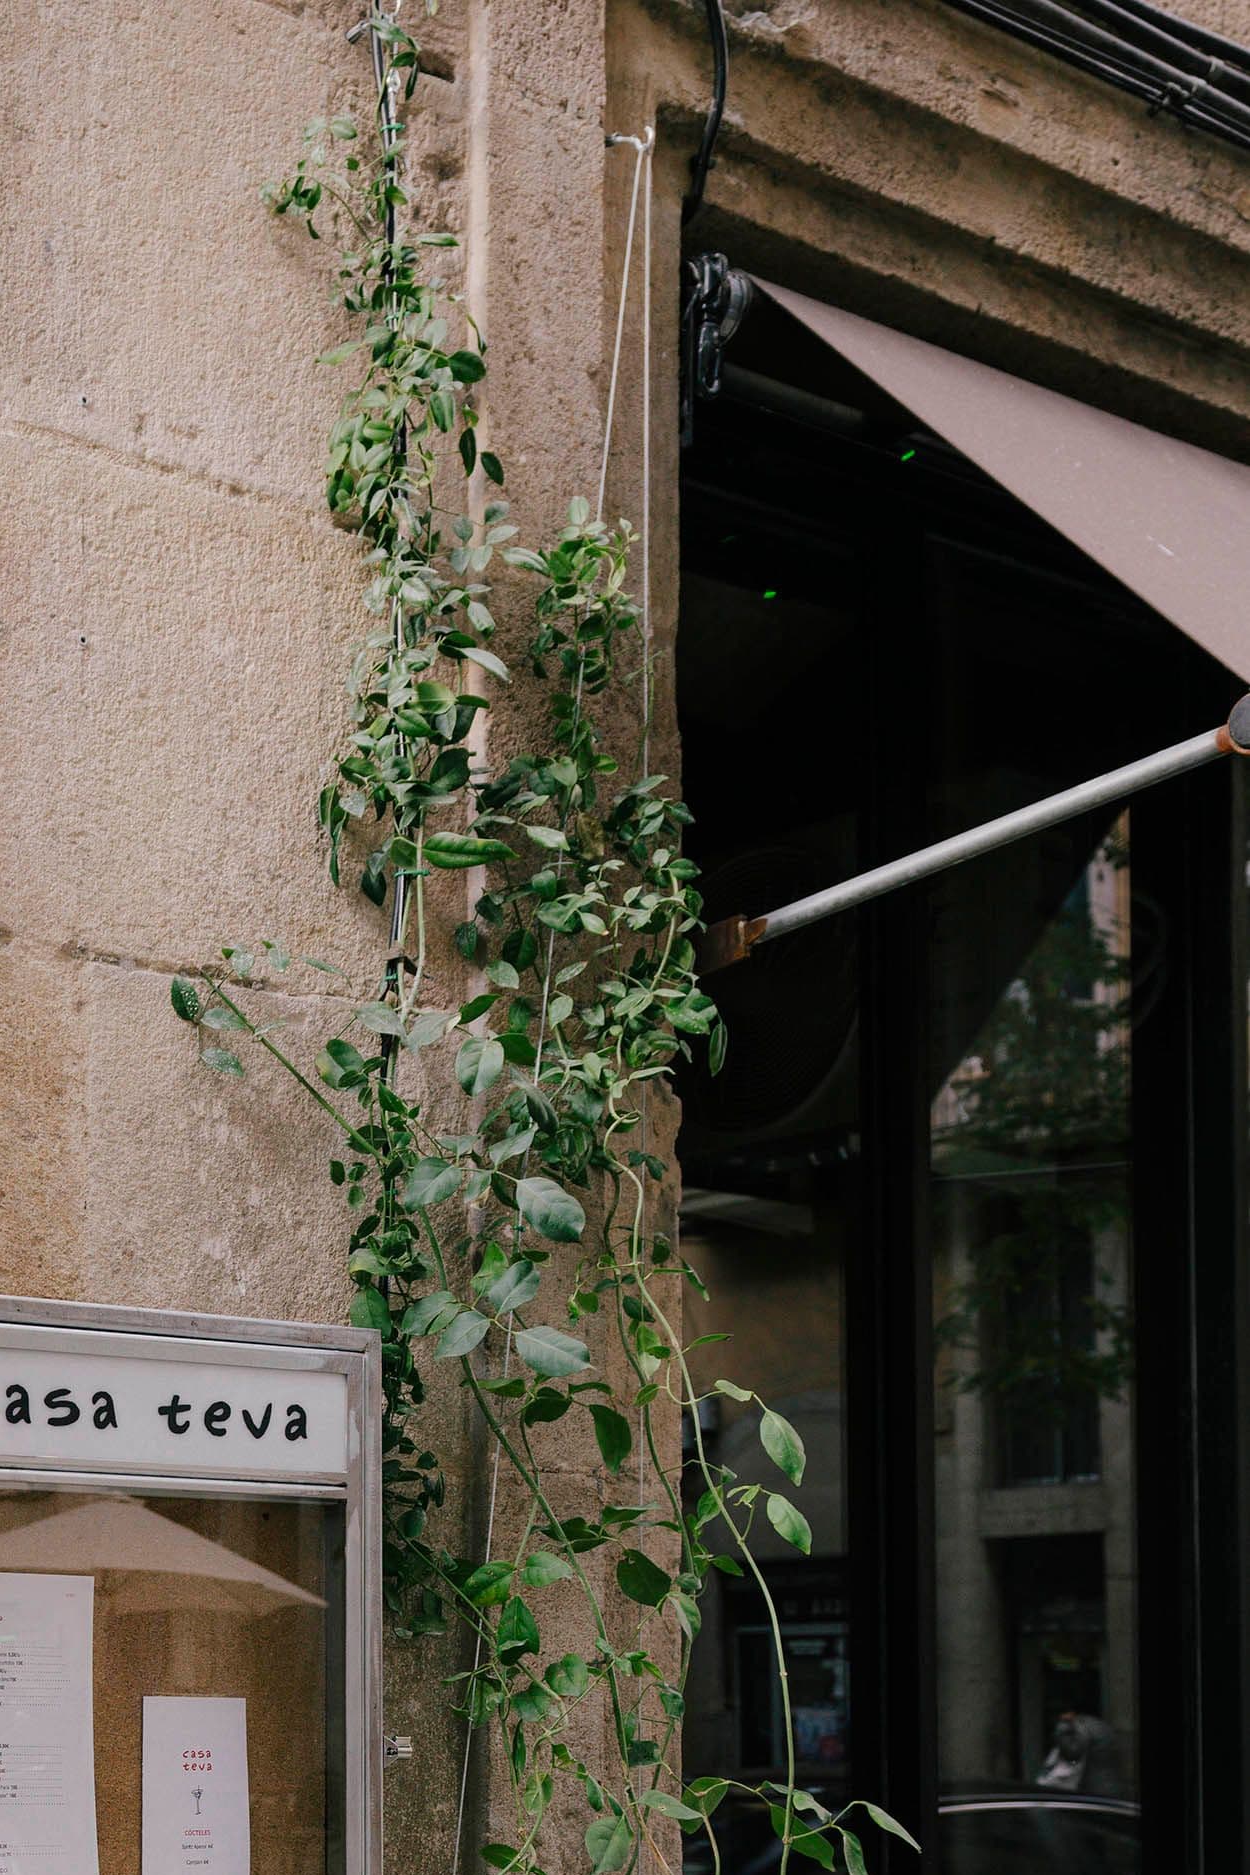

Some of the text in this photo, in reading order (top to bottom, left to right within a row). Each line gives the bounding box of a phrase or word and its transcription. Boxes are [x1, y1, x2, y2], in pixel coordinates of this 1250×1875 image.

[158, 1395, 308, 1442] teva
[182, 1750, 212, 1759] casa
[182, 1762, 213, 1772] teva
